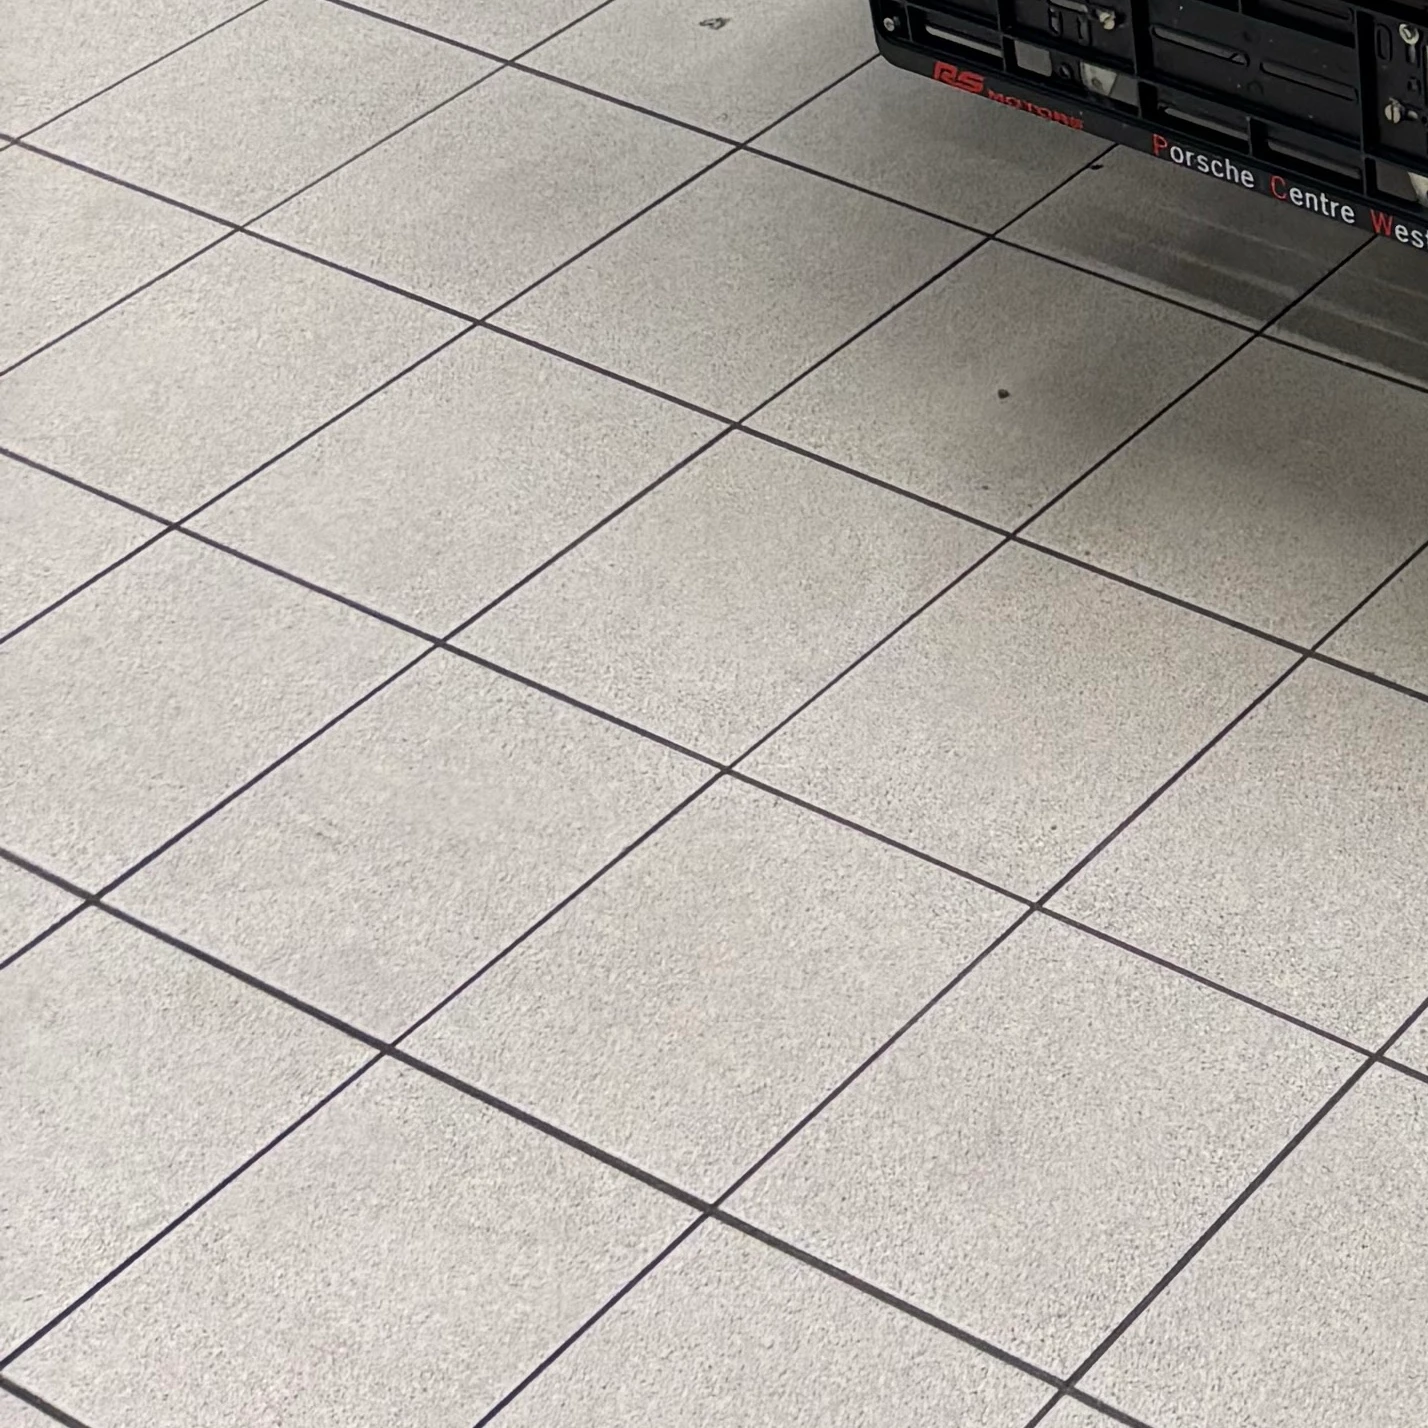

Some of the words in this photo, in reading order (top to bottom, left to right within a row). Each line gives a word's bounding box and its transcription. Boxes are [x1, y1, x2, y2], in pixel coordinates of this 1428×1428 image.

[934, 61, 984, 93] RS
[988, 90, 1084, 130] MOTORS
[1152, 133, 1255, 188] Porsche
[1270, 176, 1355, 224] Centre
